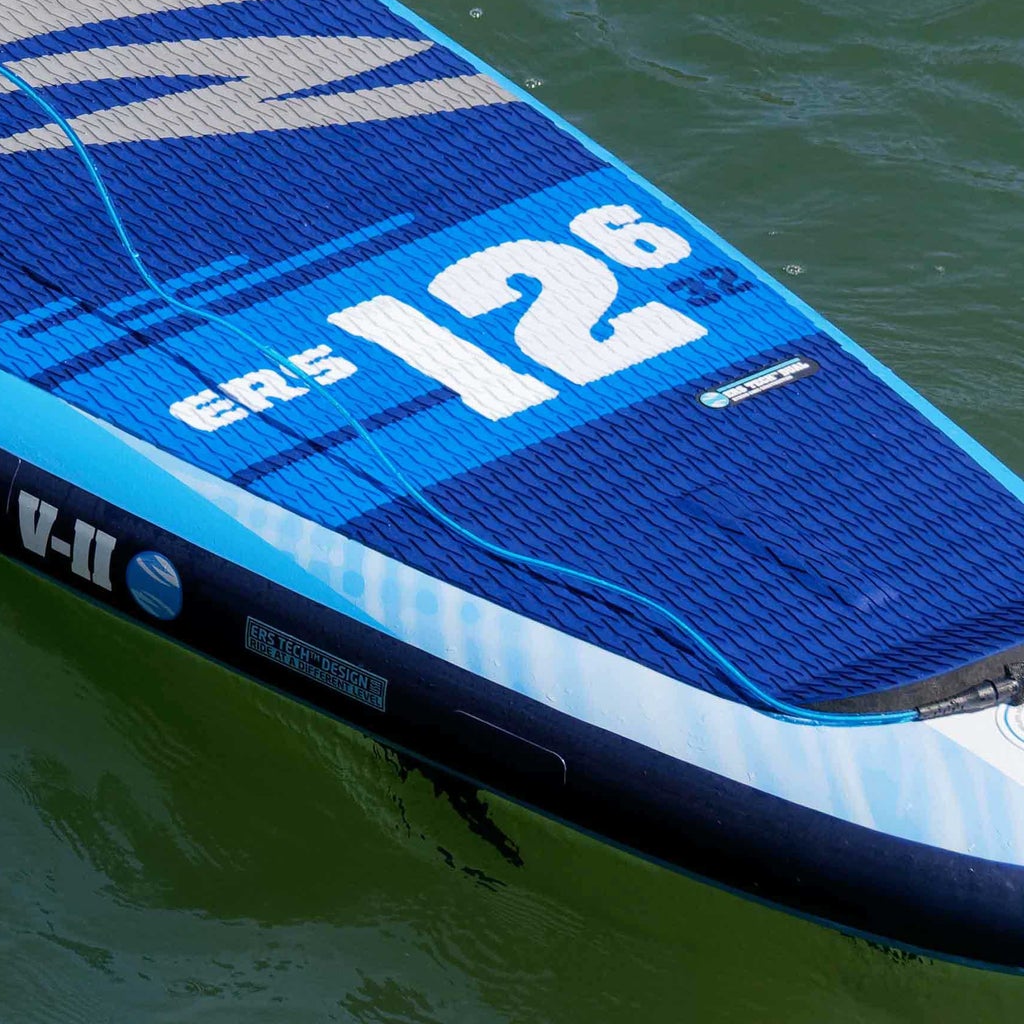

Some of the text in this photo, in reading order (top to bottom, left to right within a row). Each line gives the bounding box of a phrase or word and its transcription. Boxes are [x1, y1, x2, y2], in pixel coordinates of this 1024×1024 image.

[666, 265, 756, 308] 32
[169, 238, 708, 433] ERS 12
[250, 624, 275, 645] ERS
[321, 658, 368, 688] DESIGN
[250, 638, 273, 655] RIDE
[351, 684, 382, 707] LEVEL
